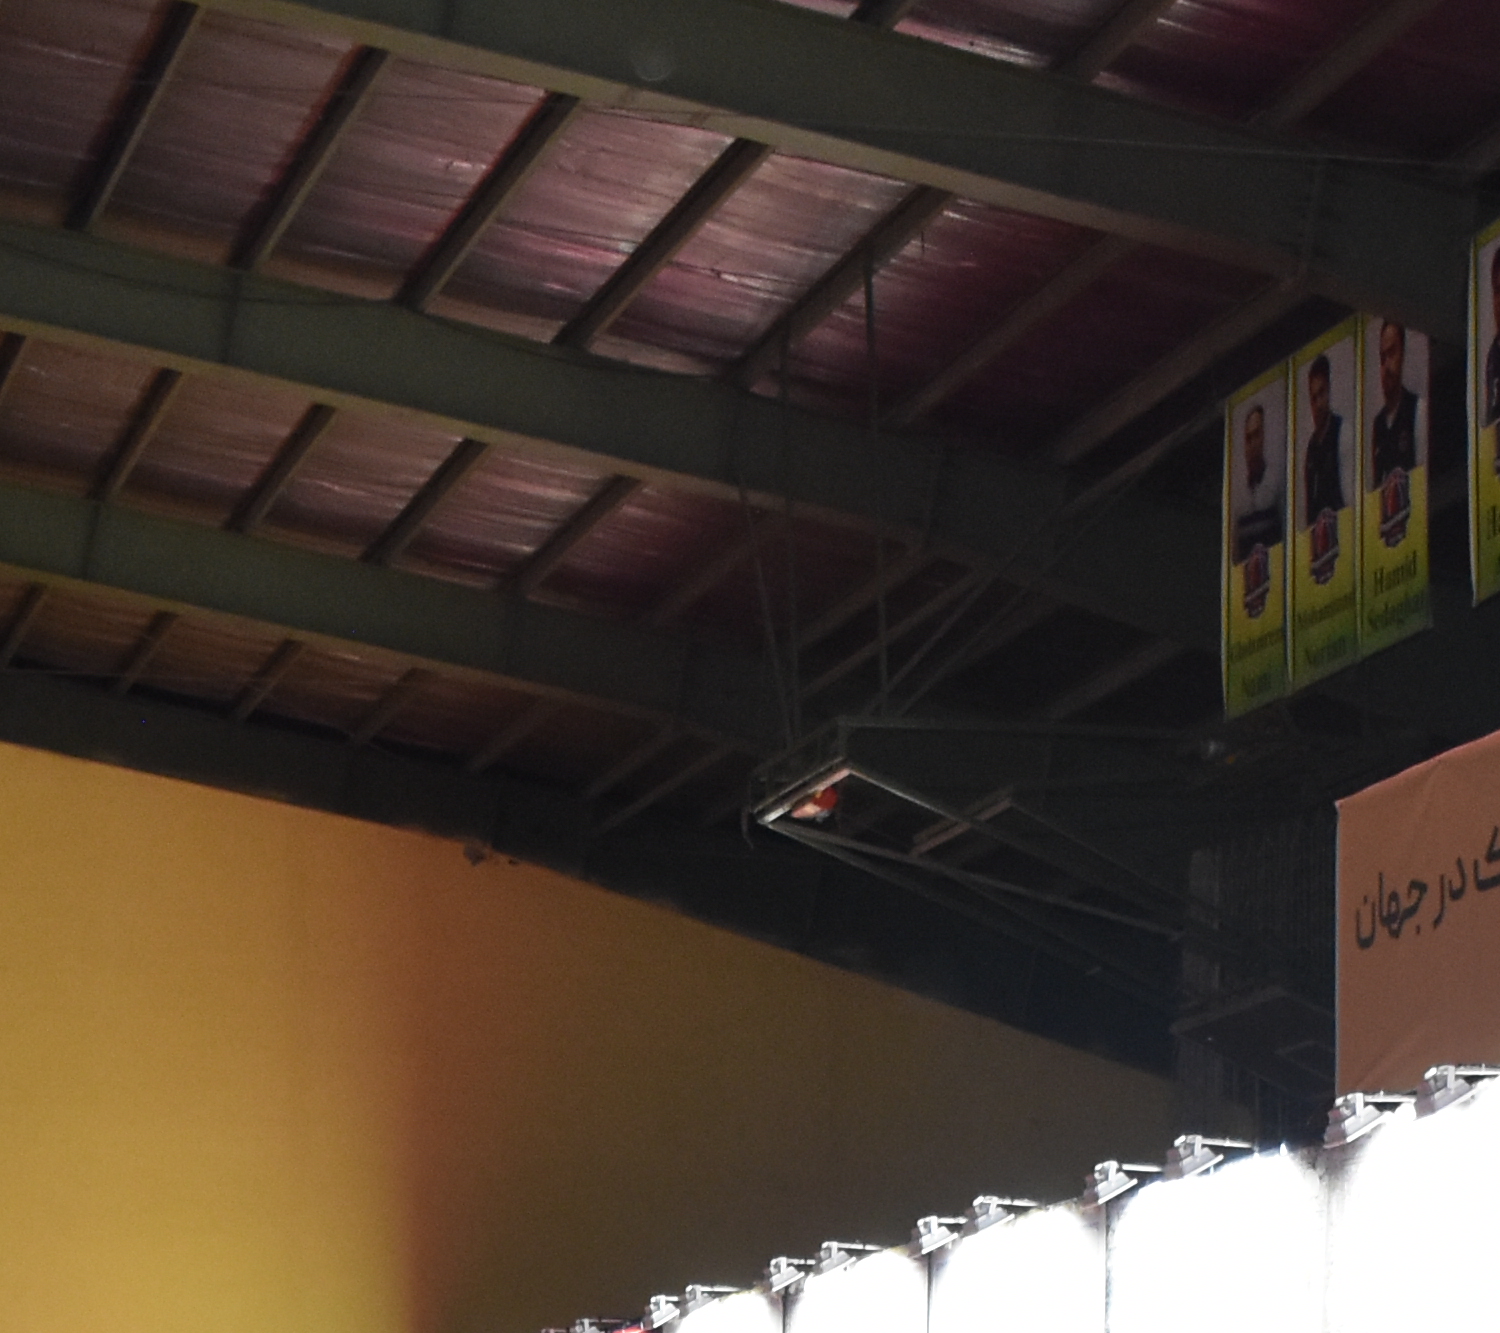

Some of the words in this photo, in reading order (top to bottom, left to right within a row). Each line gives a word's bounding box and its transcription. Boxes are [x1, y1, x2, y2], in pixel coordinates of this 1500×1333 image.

[1374, 550, 1418, 597] Hamid
[1356, 871, 1428, 949] جهان
[1433, 856, 1468, 926] در
